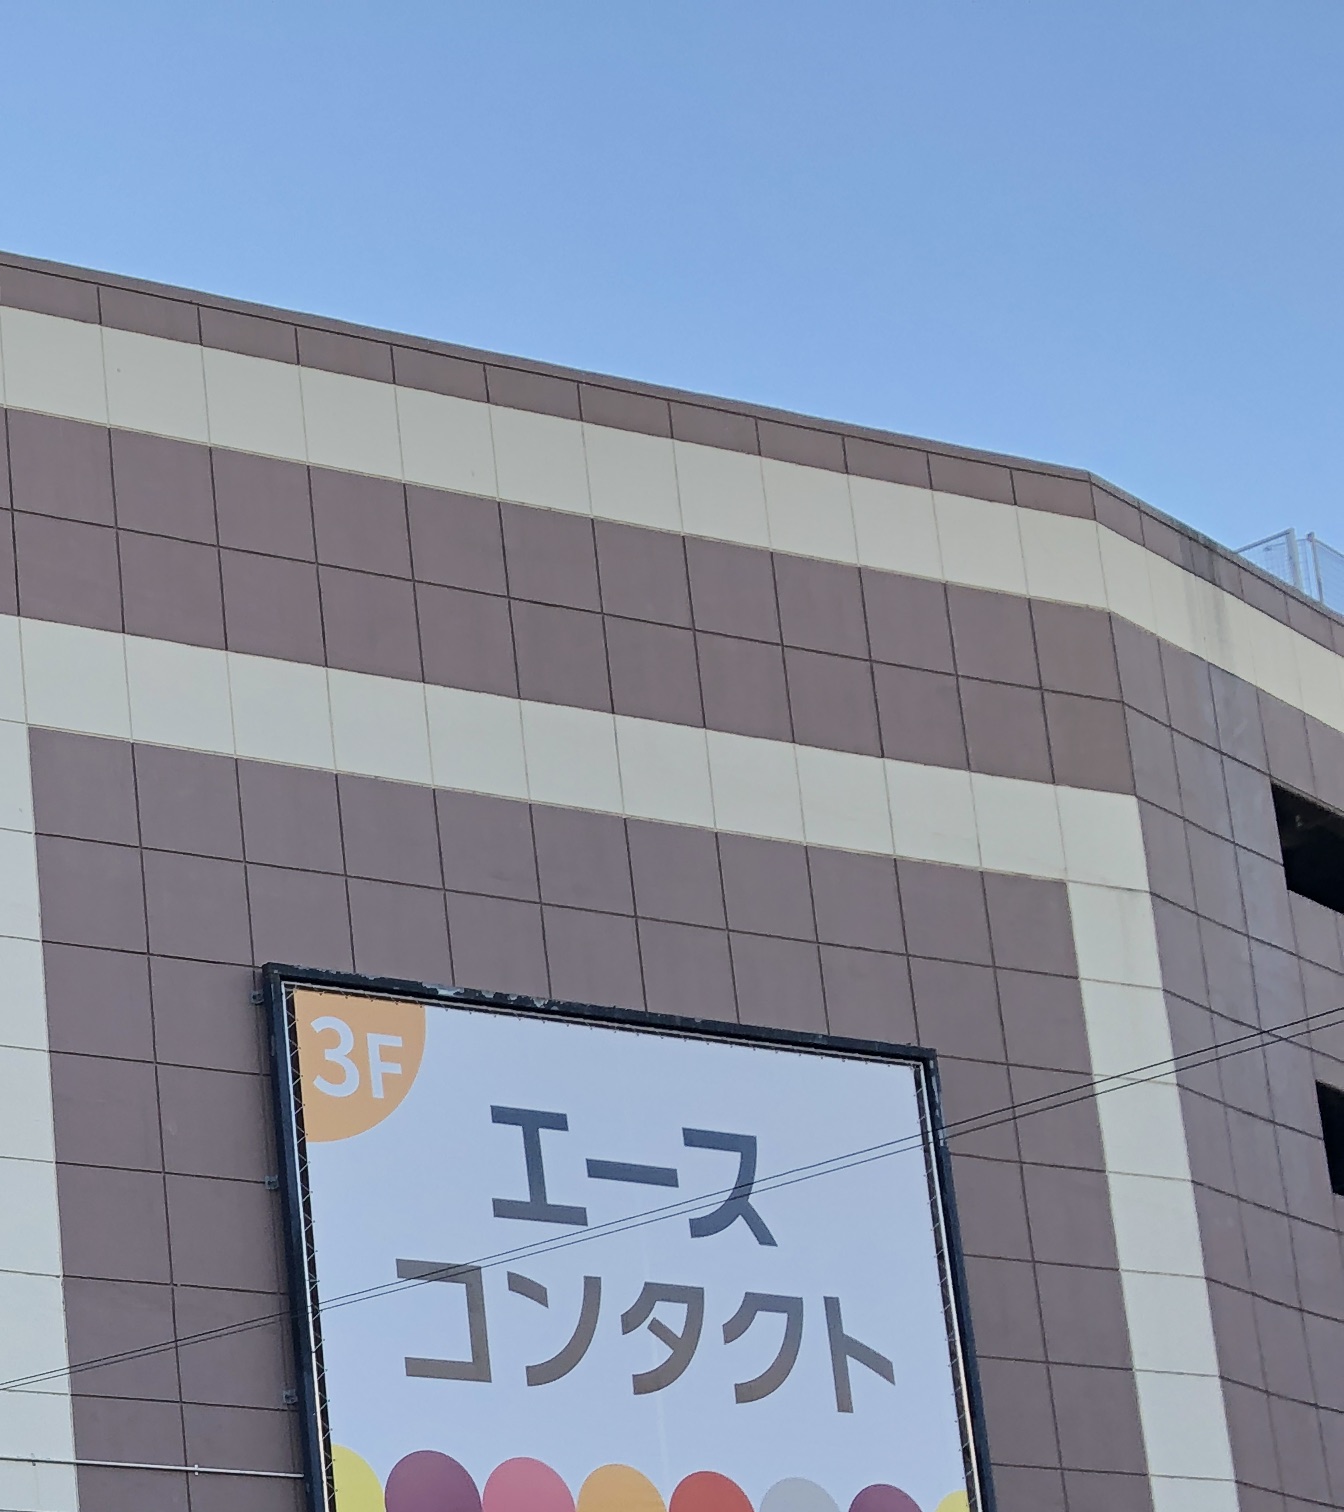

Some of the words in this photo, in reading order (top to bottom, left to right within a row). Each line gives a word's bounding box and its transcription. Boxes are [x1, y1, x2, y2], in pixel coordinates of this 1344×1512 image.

[310, 1015, 404, 1101] 3F
[489, 1104, 778, 1248] エース
[395, 1258, 896, 1414] コンタクト
